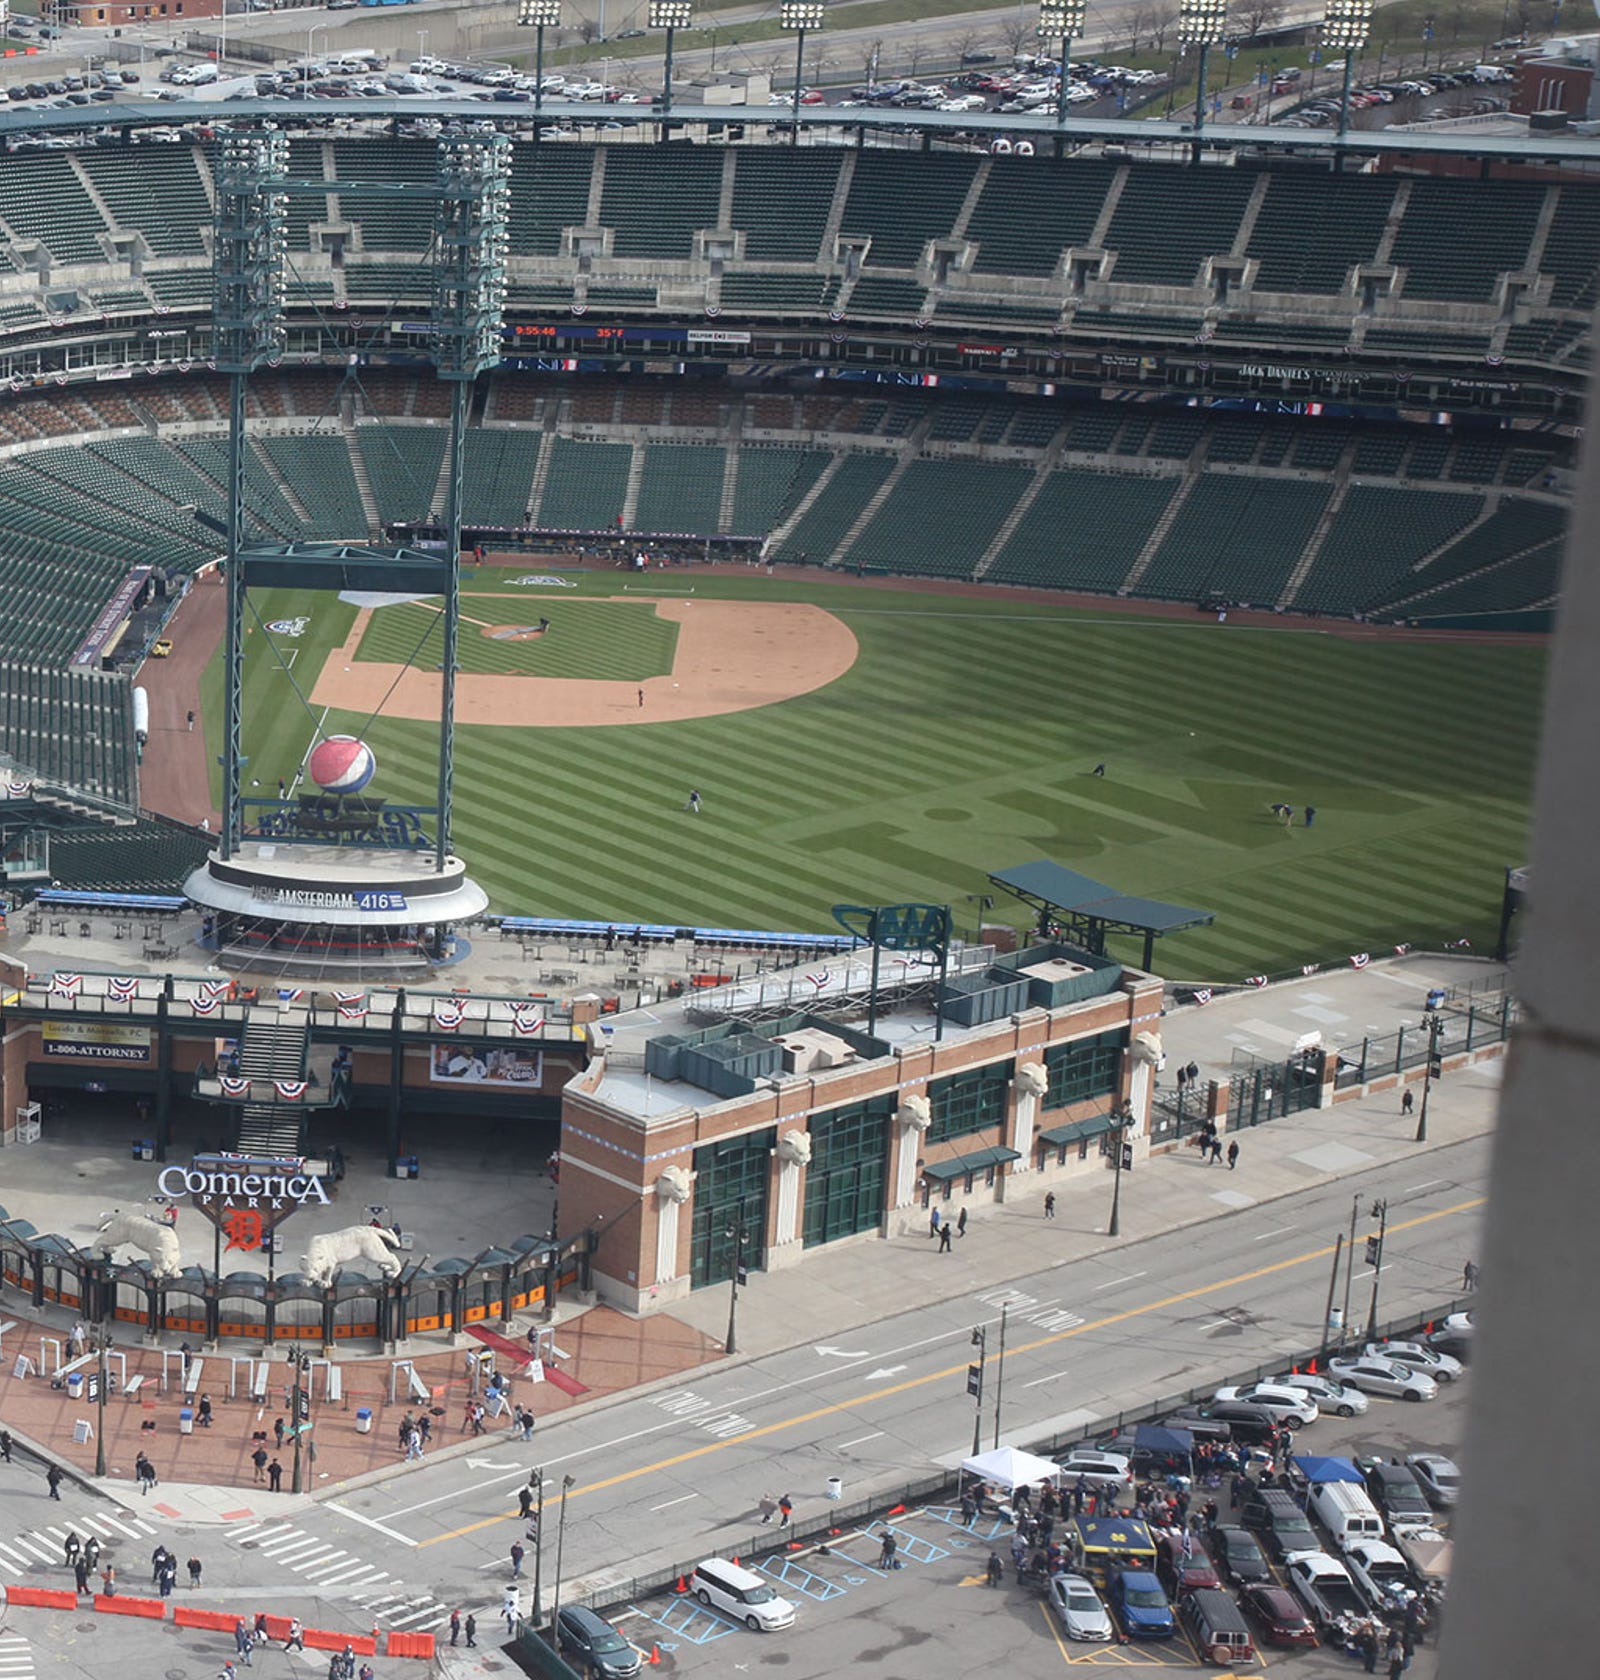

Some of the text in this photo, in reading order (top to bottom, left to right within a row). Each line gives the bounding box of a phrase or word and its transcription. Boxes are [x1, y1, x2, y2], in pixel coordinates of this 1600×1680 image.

[278, 889, 353, 909] AMSTERDAM
[360, 893, 389, 909] 416
[47, 1044, 146, 1059] 1-800-ATTORNEY
[202, 1194, 283, 1210] PARK
